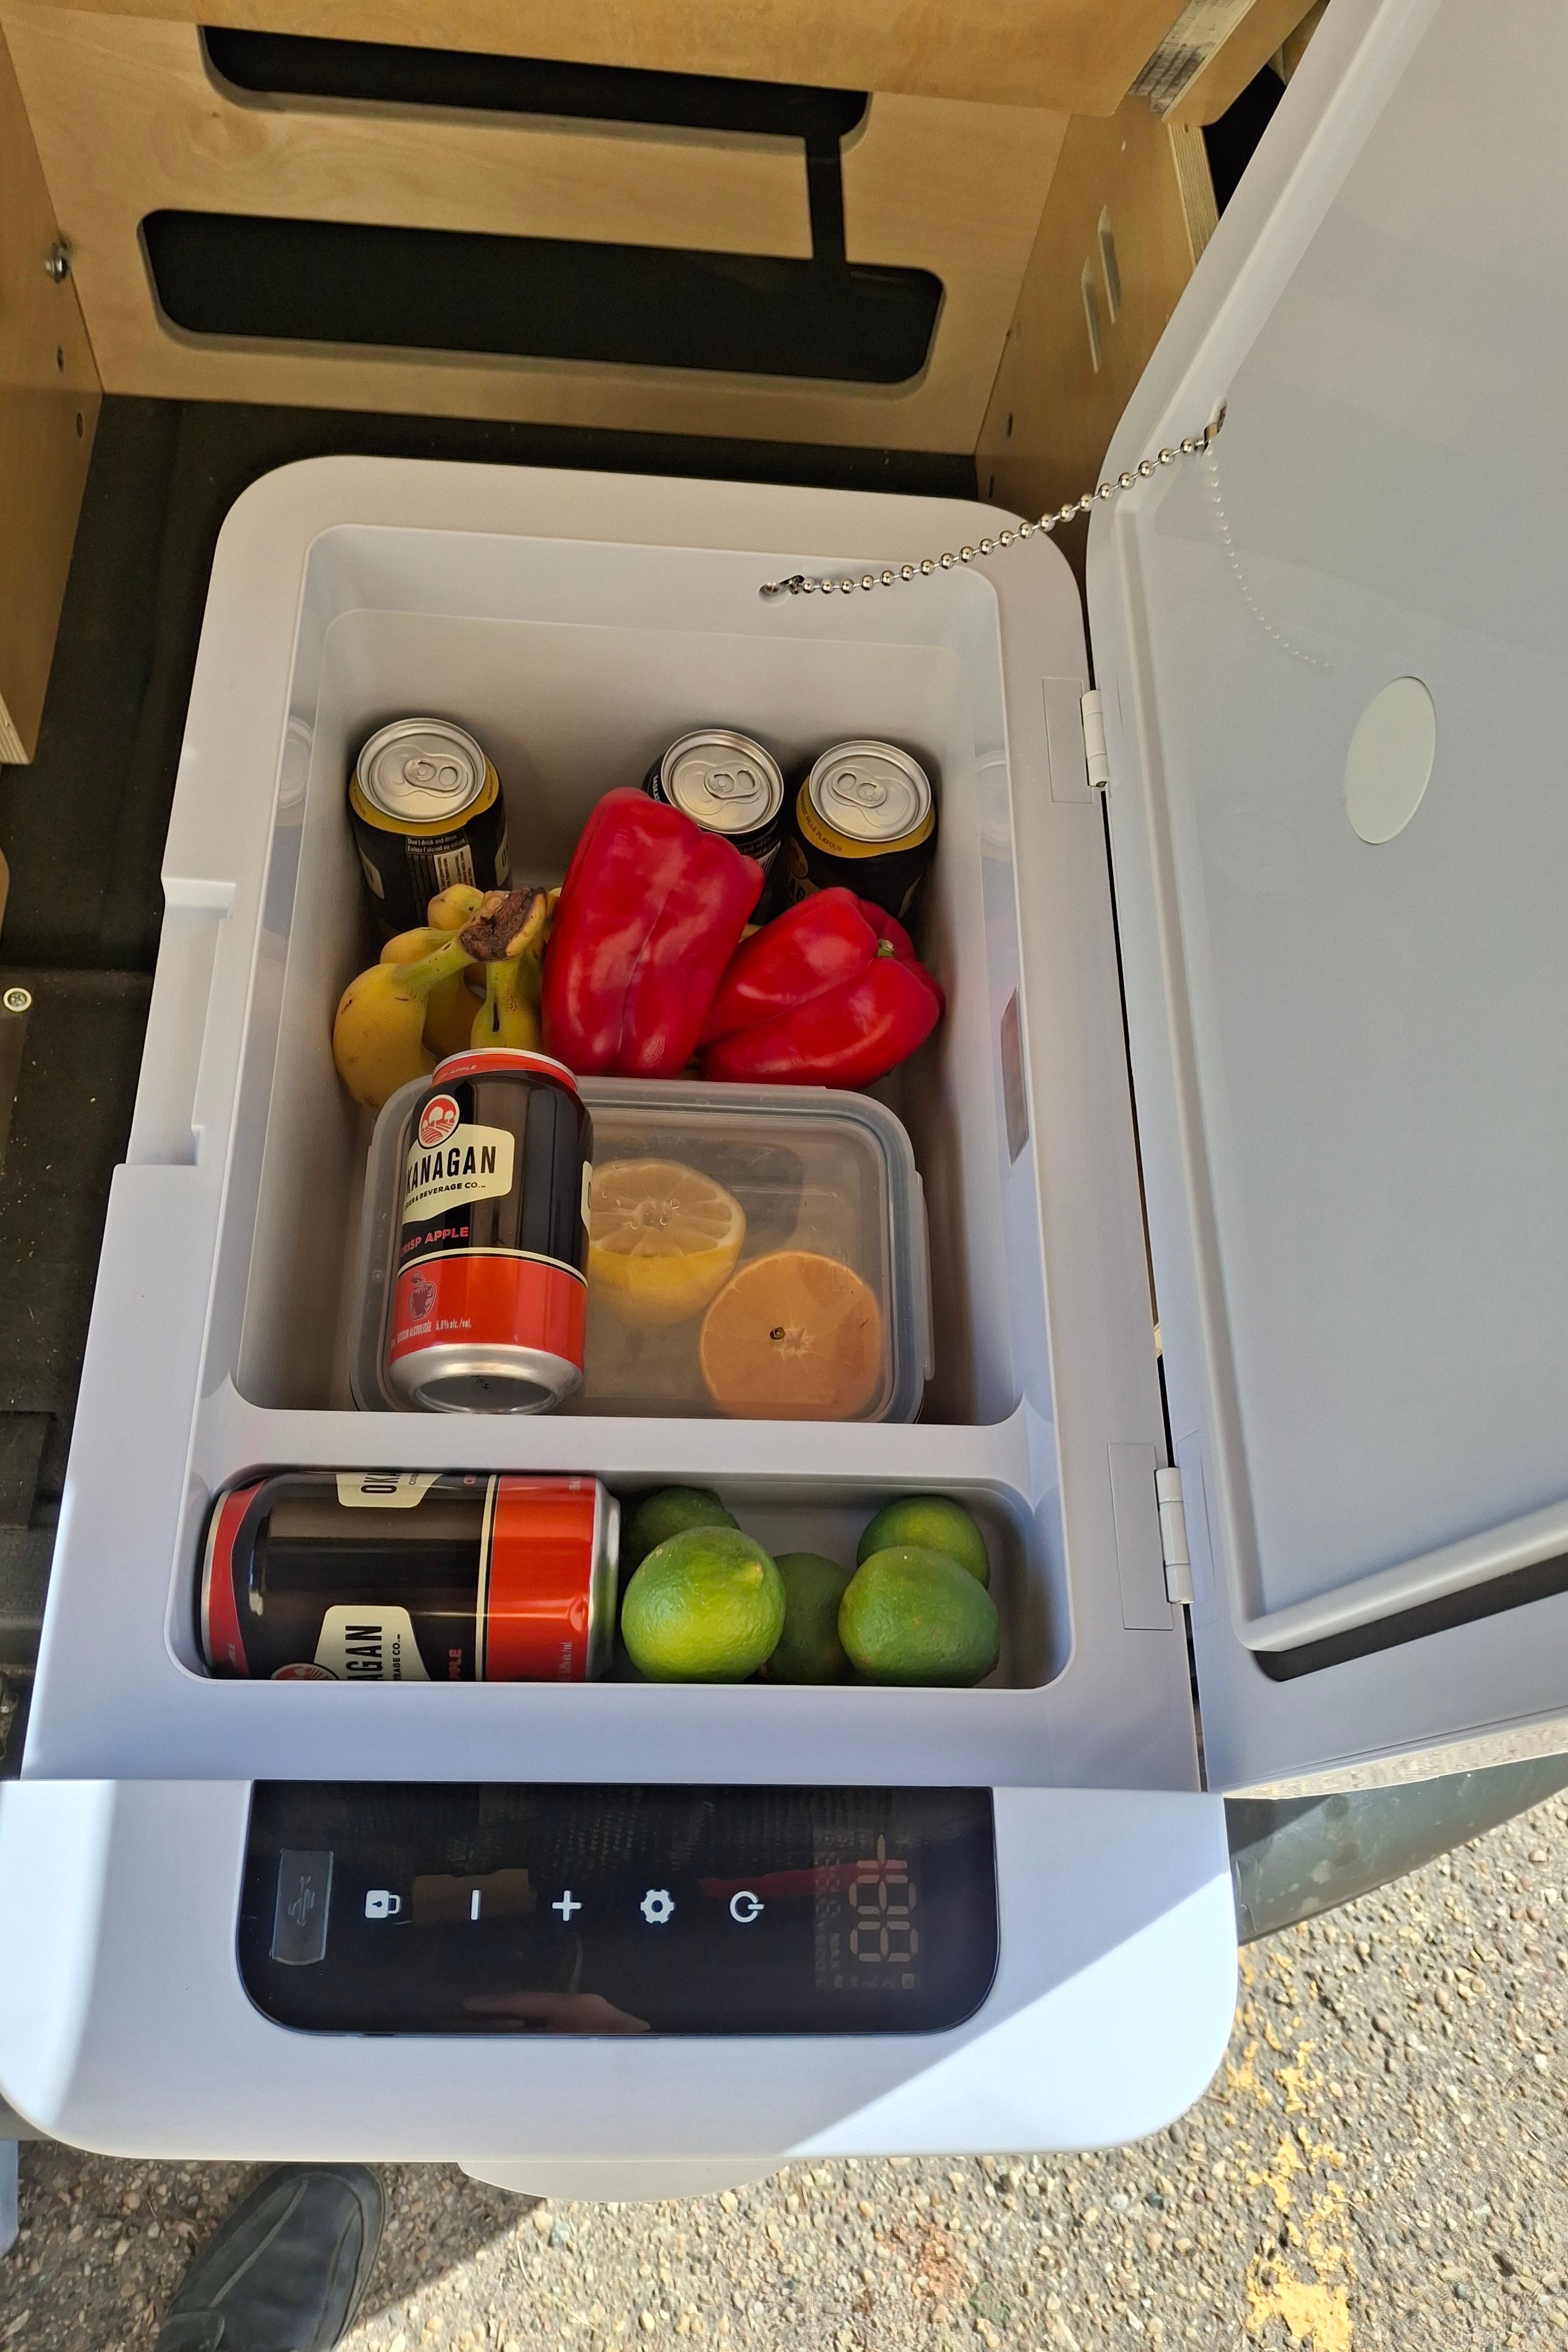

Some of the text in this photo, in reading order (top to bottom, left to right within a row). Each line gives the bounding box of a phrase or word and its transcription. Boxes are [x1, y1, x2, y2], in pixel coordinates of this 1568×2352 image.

[815, 831, 843, 851] FLAVOUR
[420, 1183, 462, 1200] BEVERAGE
[424, 1226, 469, 1245] APPLE
